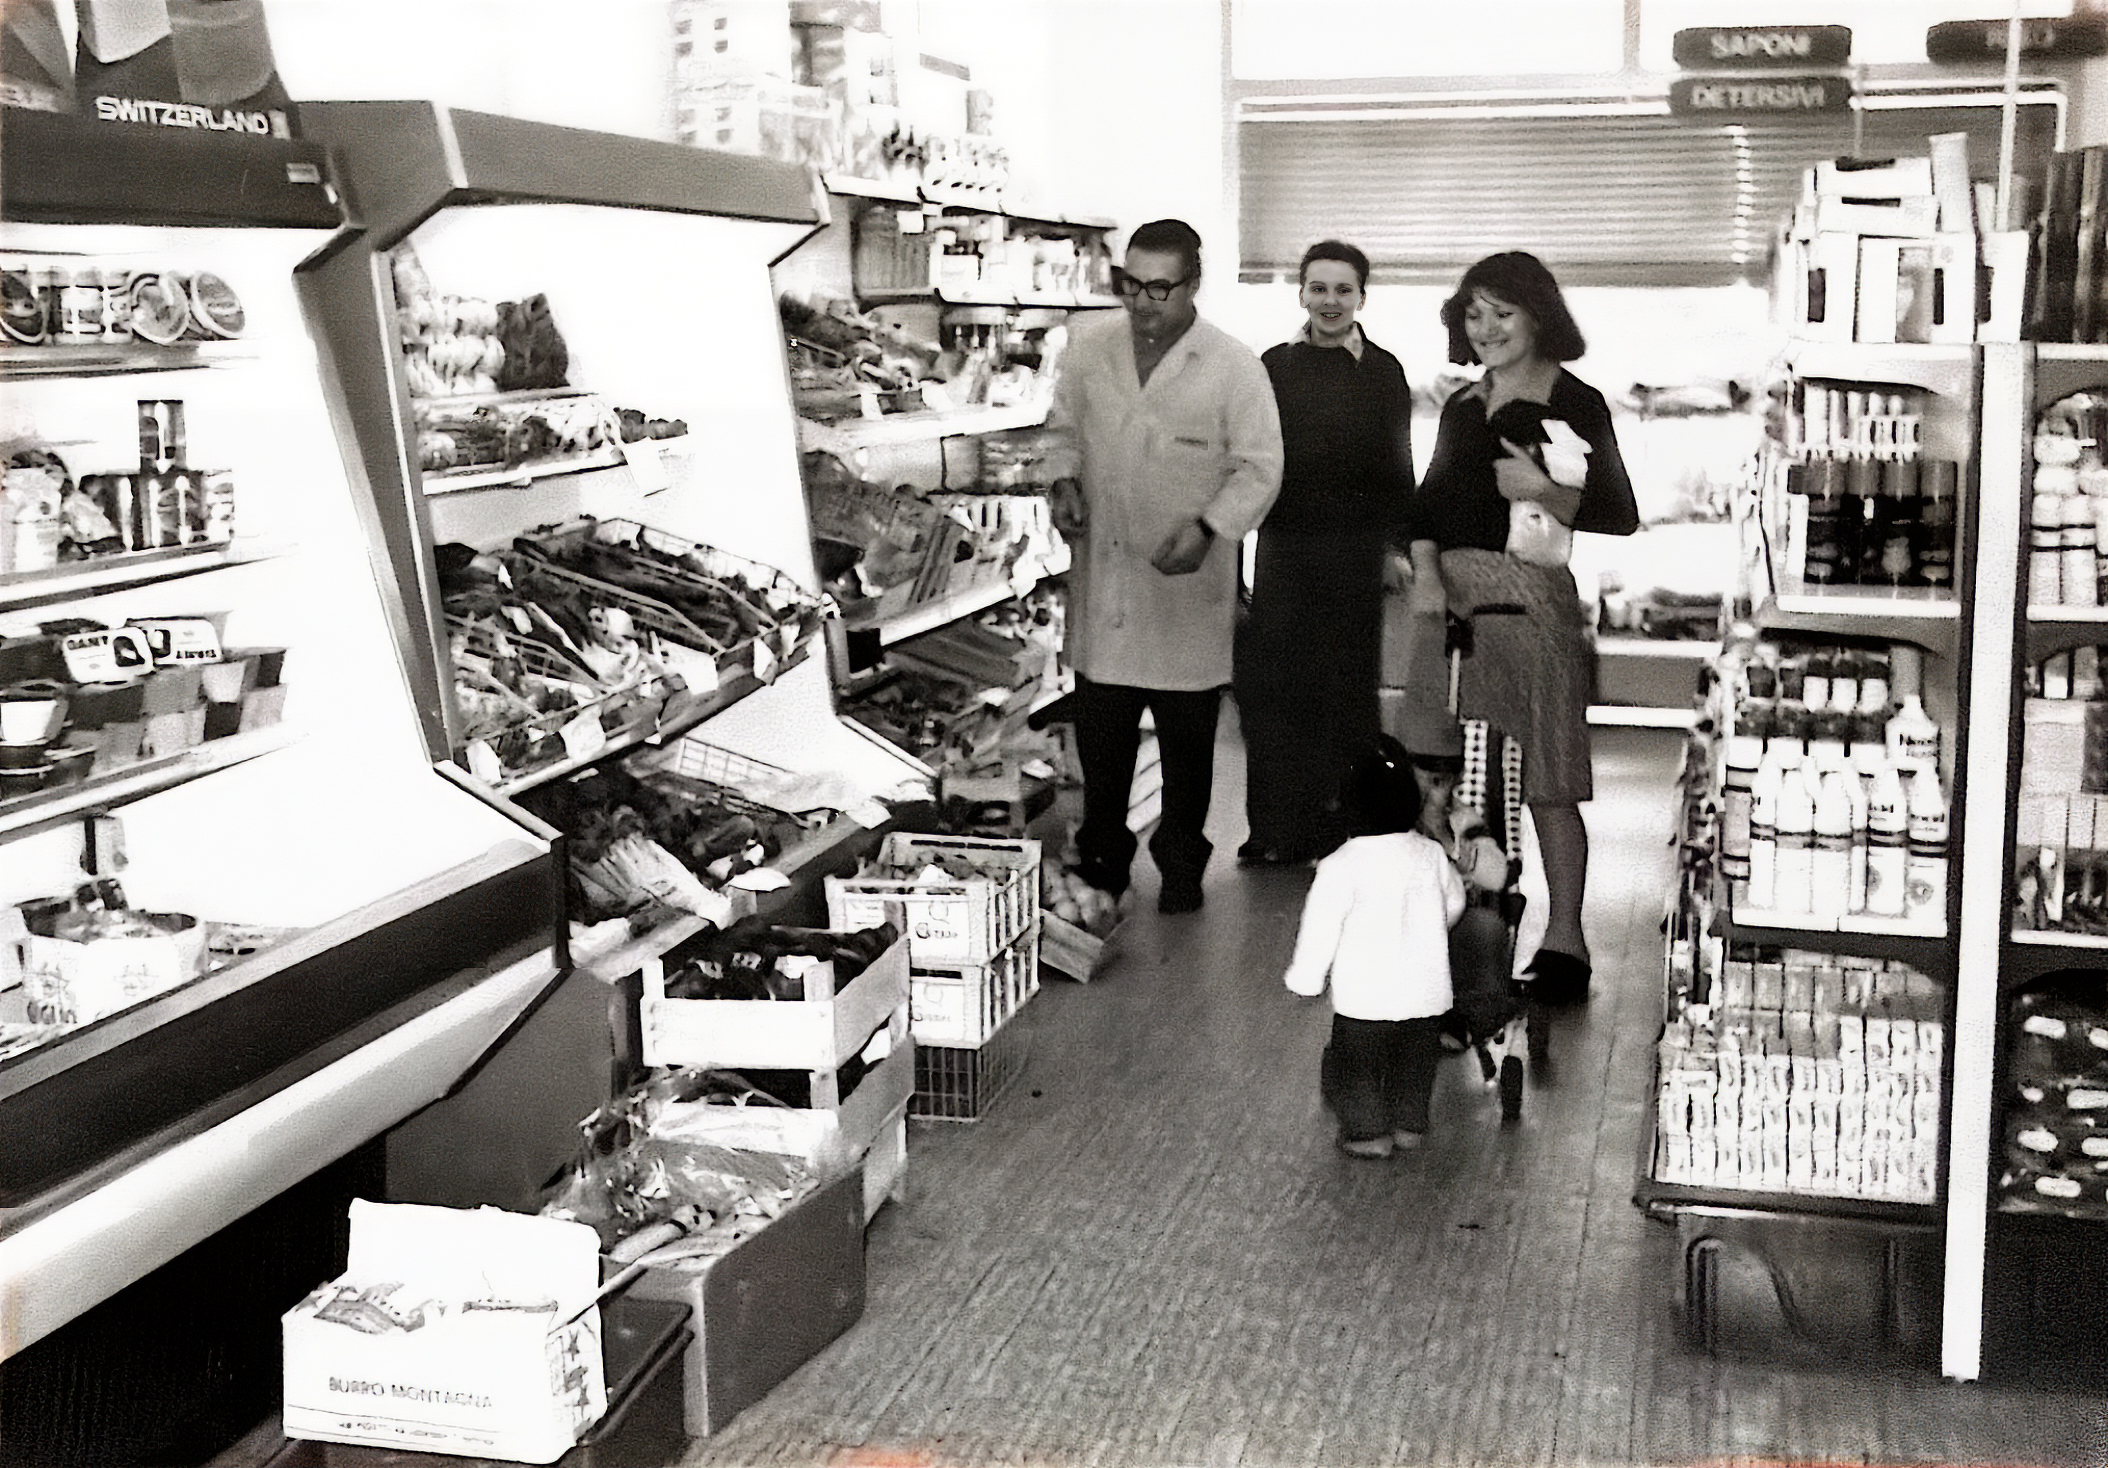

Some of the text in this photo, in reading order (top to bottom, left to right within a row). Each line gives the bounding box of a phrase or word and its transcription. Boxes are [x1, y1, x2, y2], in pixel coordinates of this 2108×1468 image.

[1709, 31, 1812, 60] SAPONI
[1690, 83, 1825, 110] DETERSIVI
[95, 95, 270, 136] SWITZERLAND
[328, 1375, 385, 1397] BURRO
